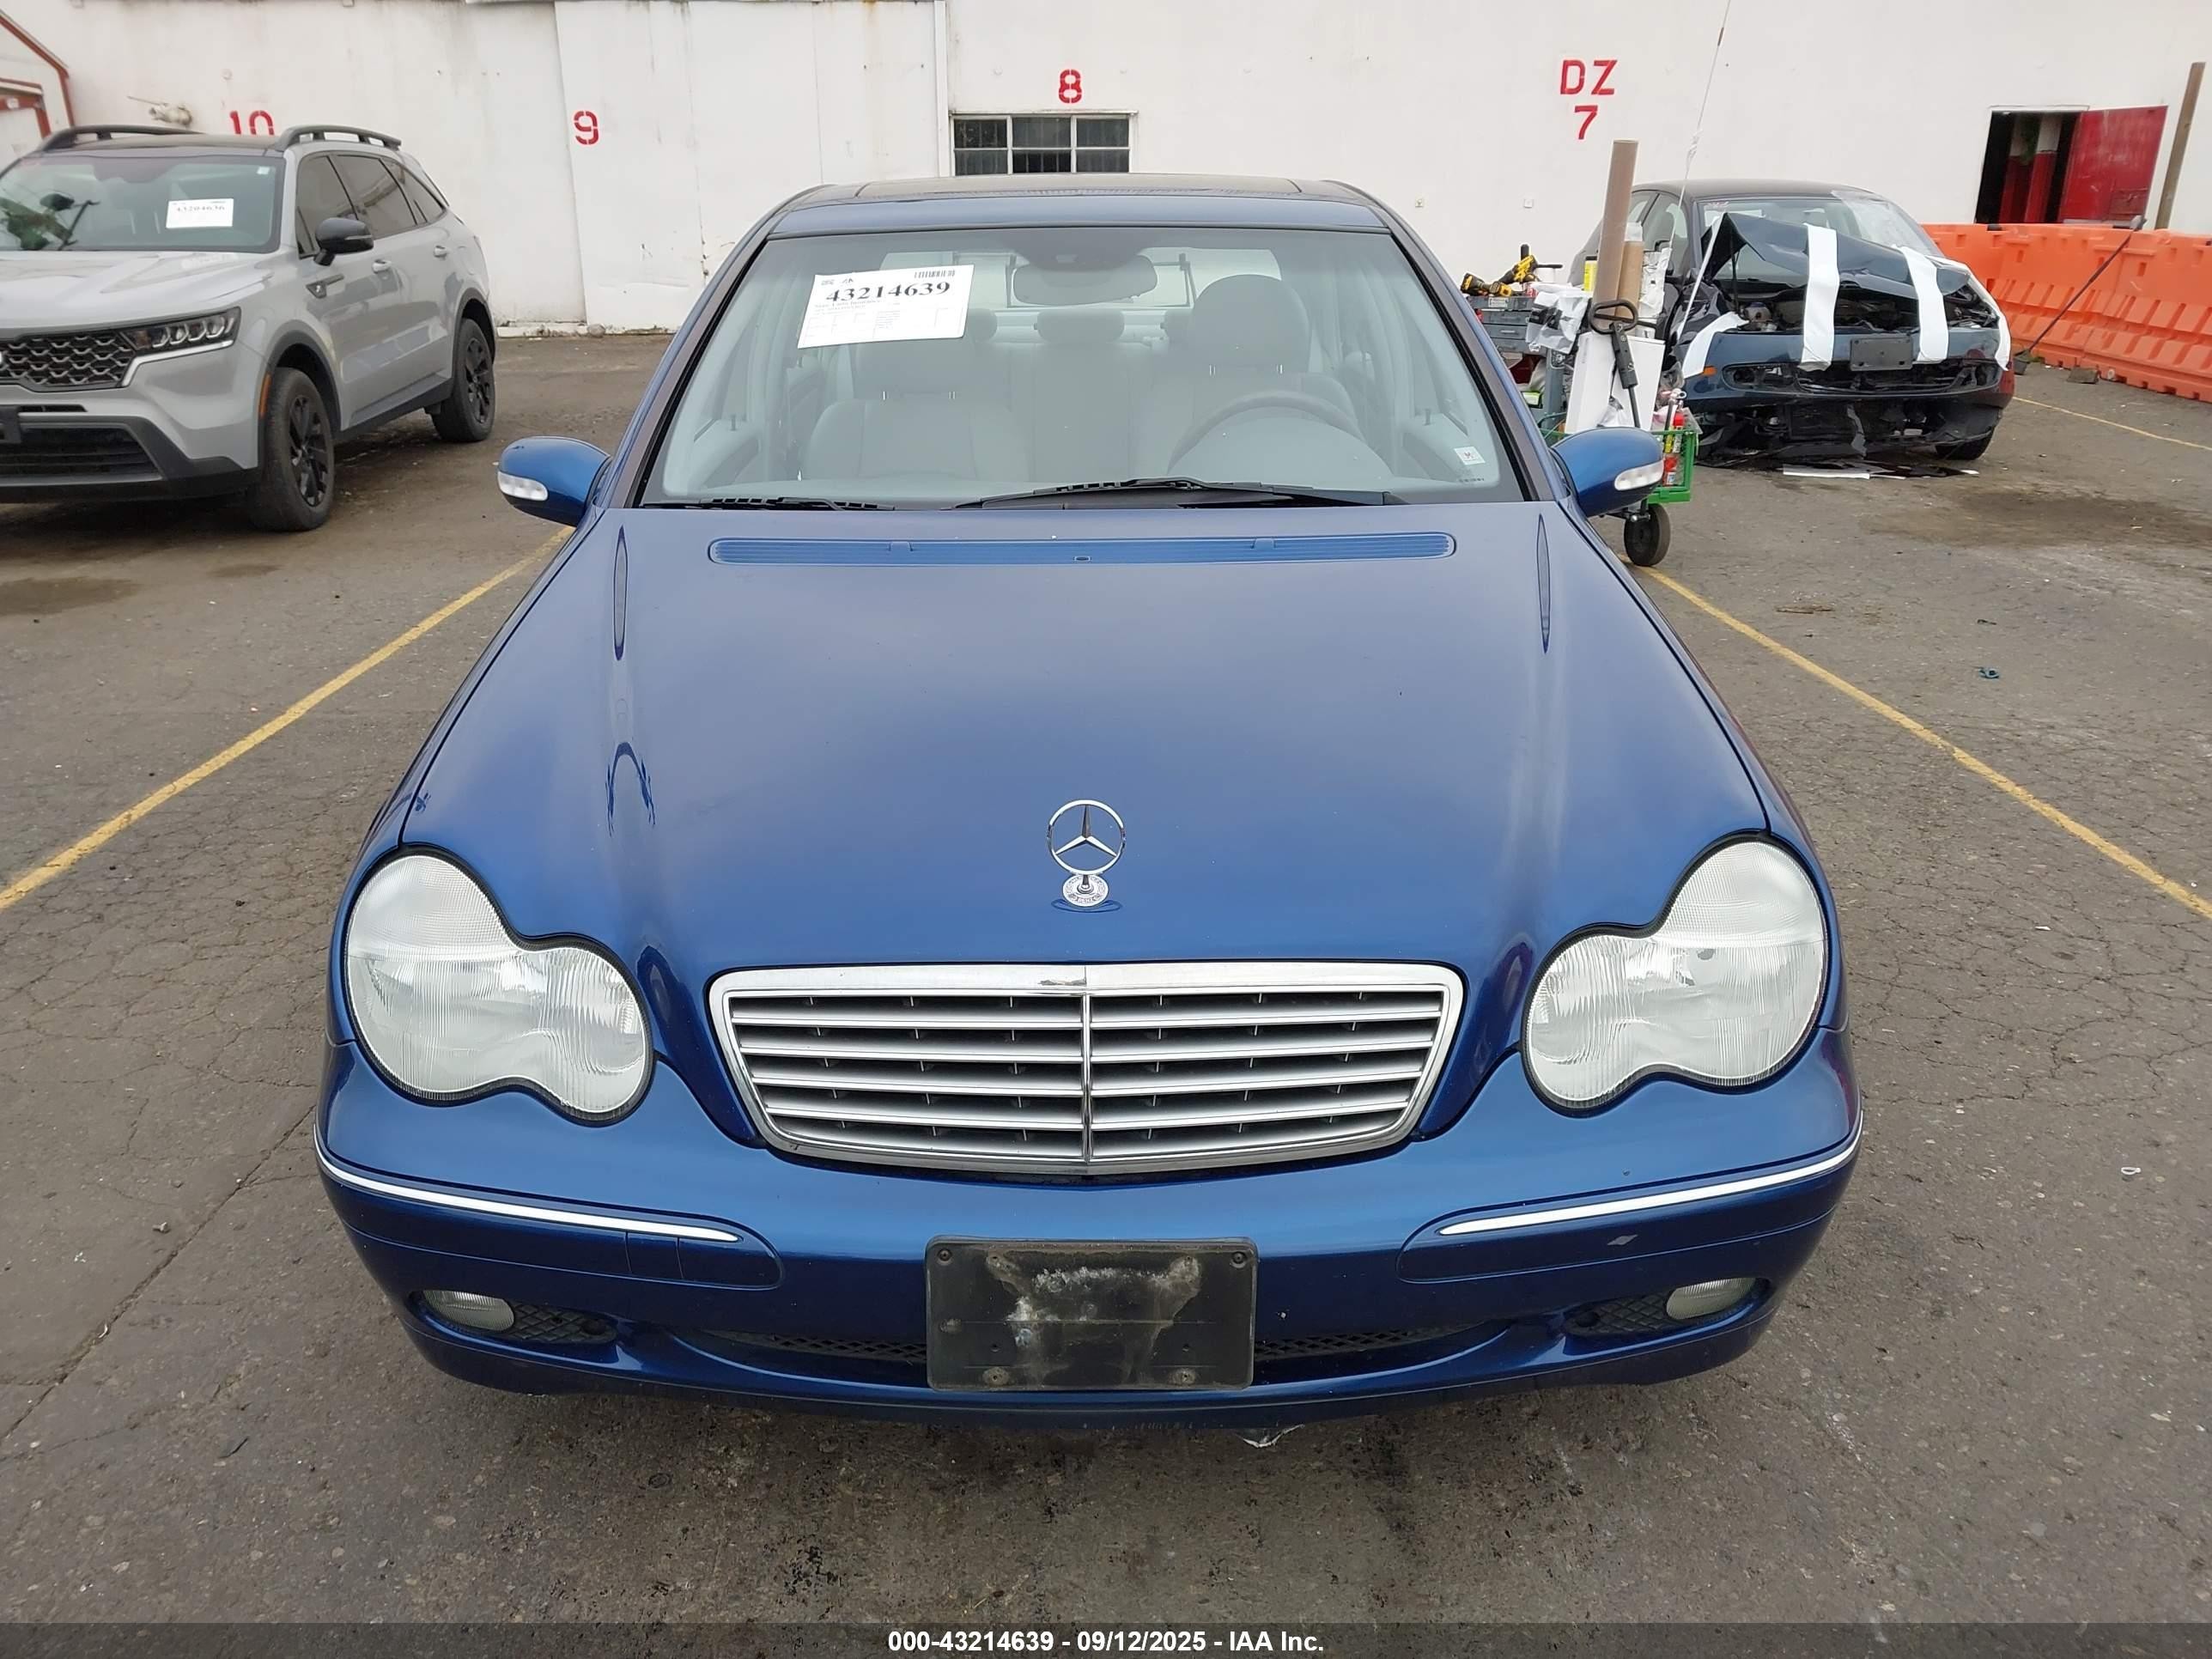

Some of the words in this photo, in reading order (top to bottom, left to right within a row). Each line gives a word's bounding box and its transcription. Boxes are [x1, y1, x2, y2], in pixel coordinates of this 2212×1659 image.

[1058, 69, 1082, 104] 8
[1559, 59, 1618, 95] DZ
[229, 109, 275, 136] 10
[574, 111, 599, 145] 9
[1574, 105, 1599, 140] 7
[825, 281, 951, 302] 43214639
